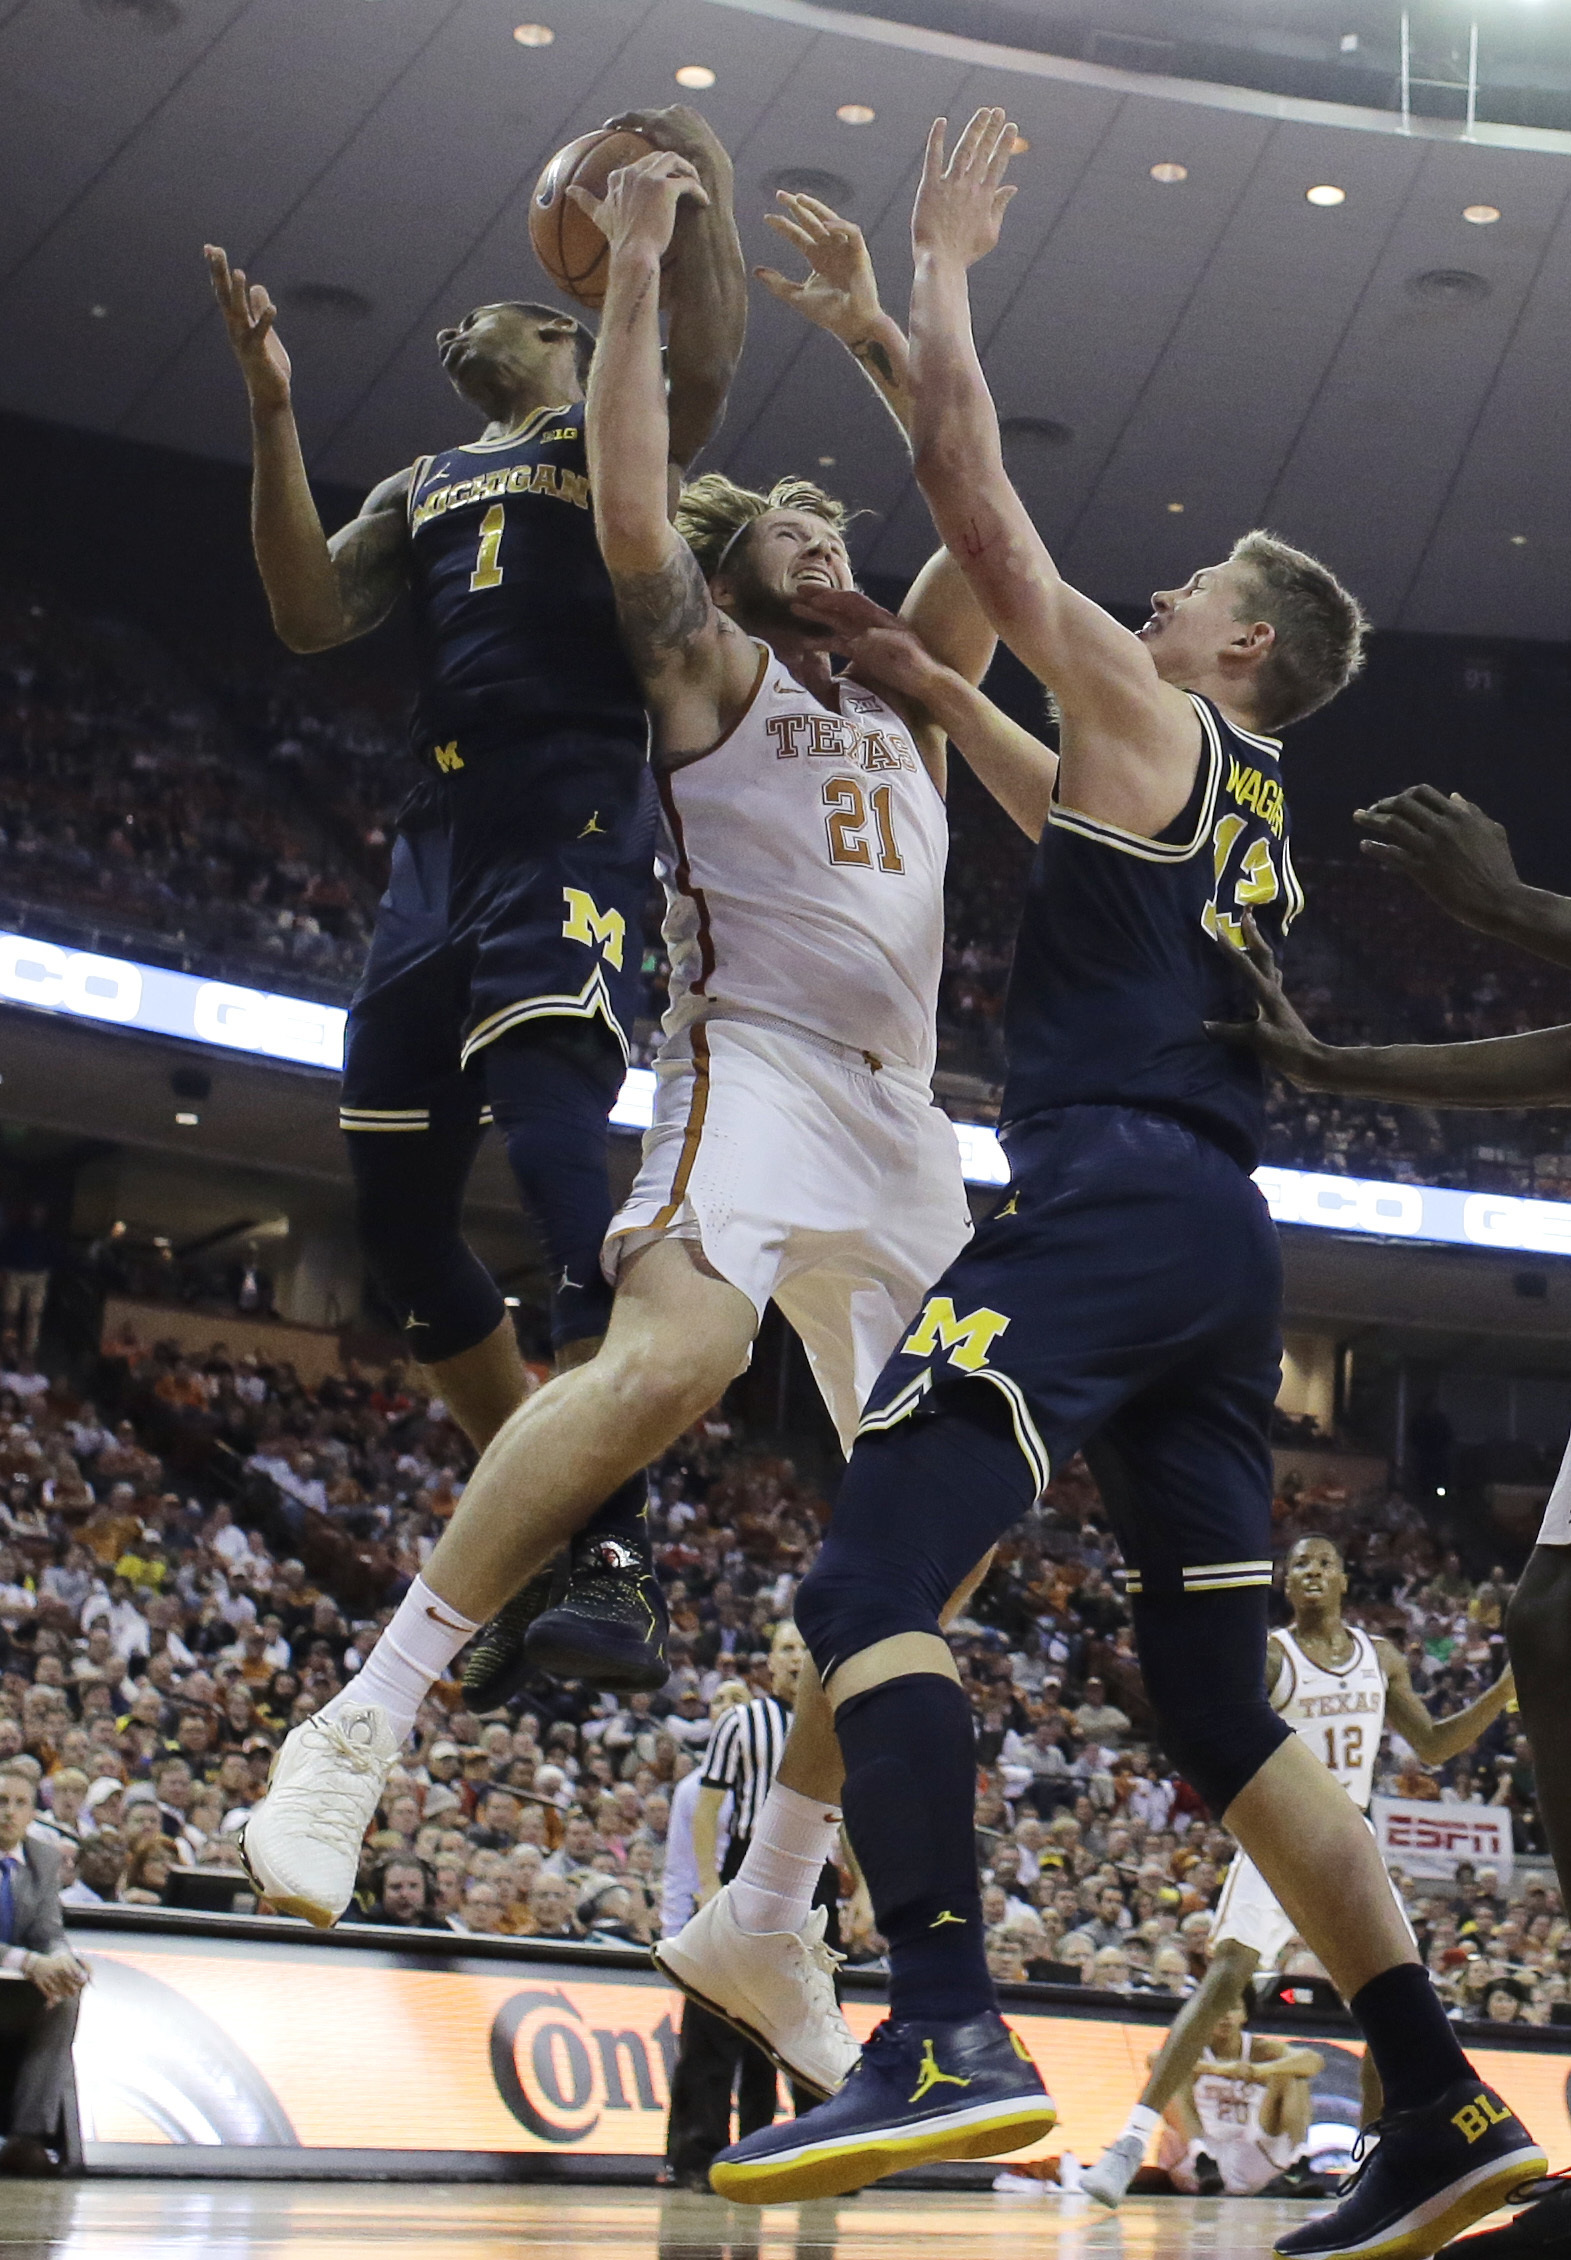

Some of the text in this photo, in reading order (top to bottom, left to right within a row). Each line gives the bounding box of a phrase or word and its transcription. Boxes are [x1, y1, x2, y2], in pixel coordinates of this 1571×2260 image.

[412, 463, 592, 539] MICHIGAN
[469, 503, 506, 593] 1
[766, 713, 918, 774] TEXAS
[821, 775, 906, 876] 21
[562, 886, 627, 974] M
[900, 1296, 1012, 1373] M
[1298, 1690, 1383, 1719] TEXAS
[1322, 1725, 1364, 1770] 12
[1387, 1813, 1501, 1855] ESPN
[1449, 2093, 1513, 2145] BL
